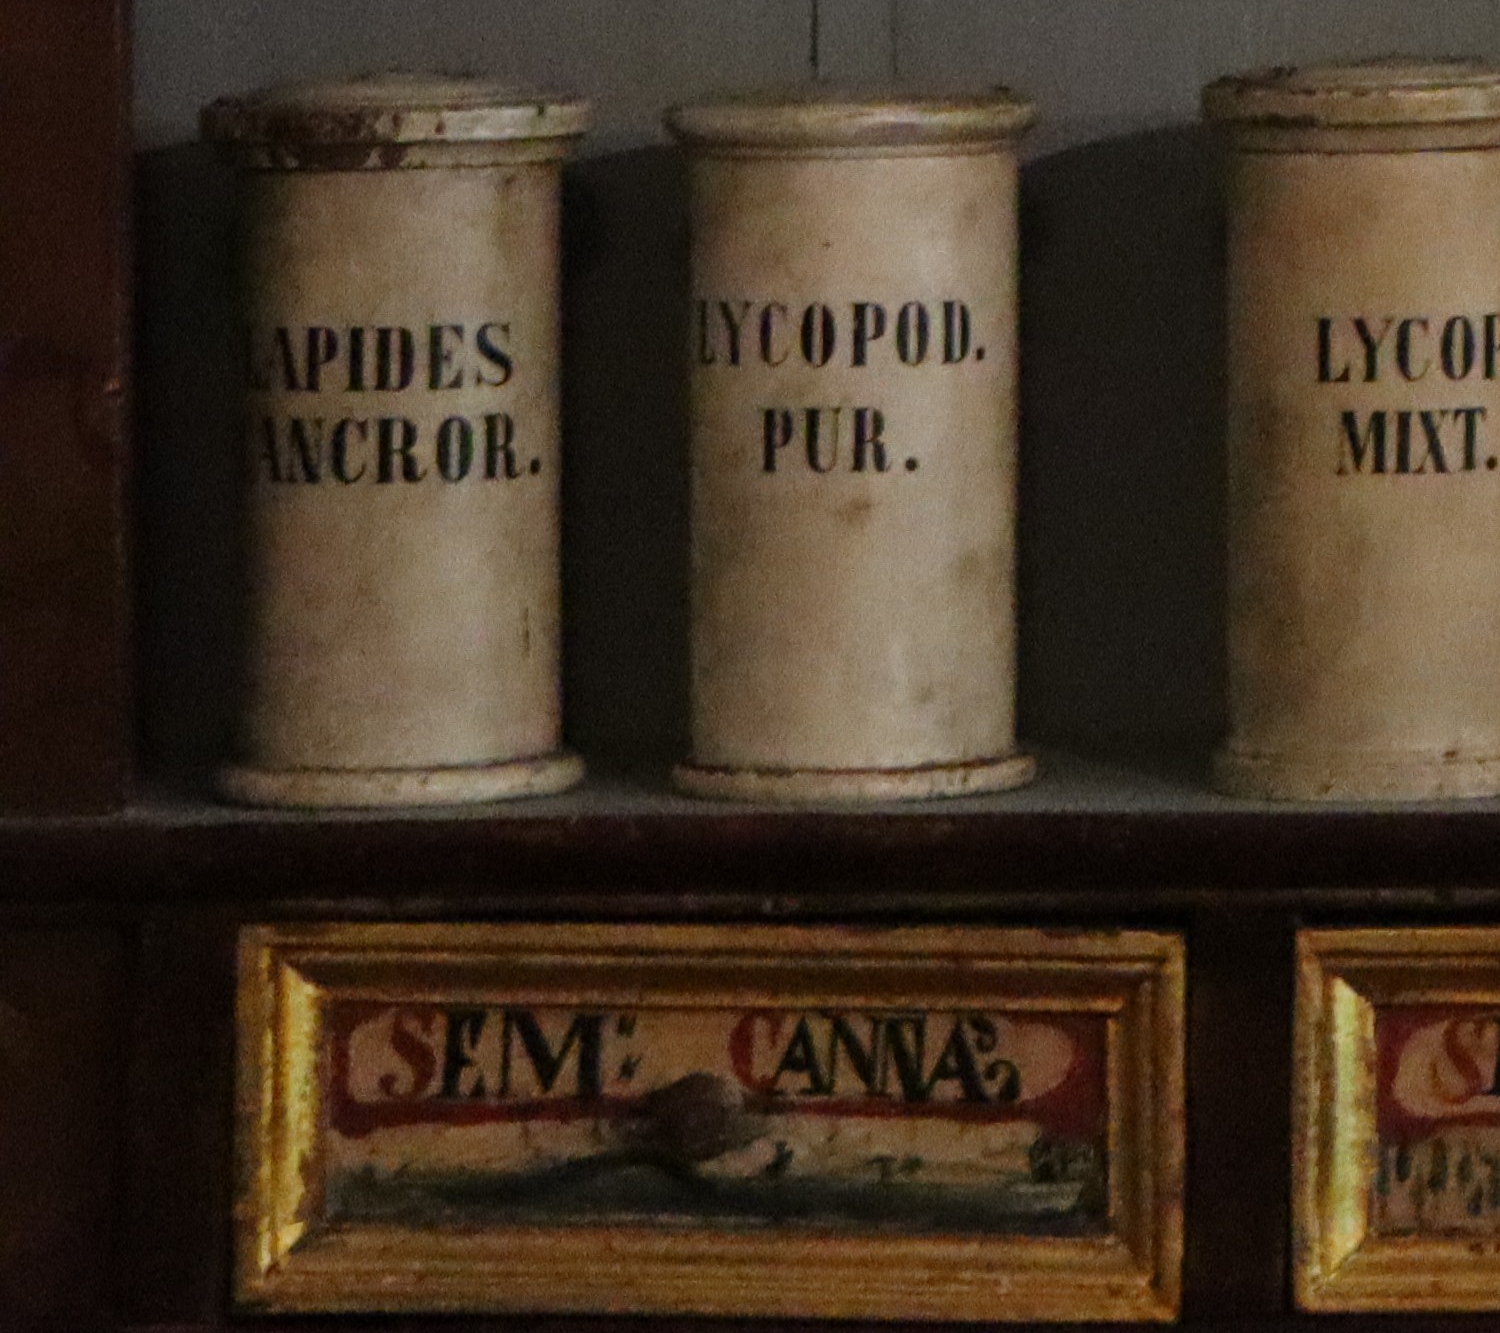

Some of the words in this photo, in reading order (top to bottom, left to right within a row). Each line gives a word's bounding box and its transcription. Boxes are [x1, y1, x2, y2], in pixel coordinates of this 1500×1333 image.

[252, 320, 513, 392] APIDES
[759, 406, 918, 474] PUR.
[1338, 407, 1498, 475] MIXT.
